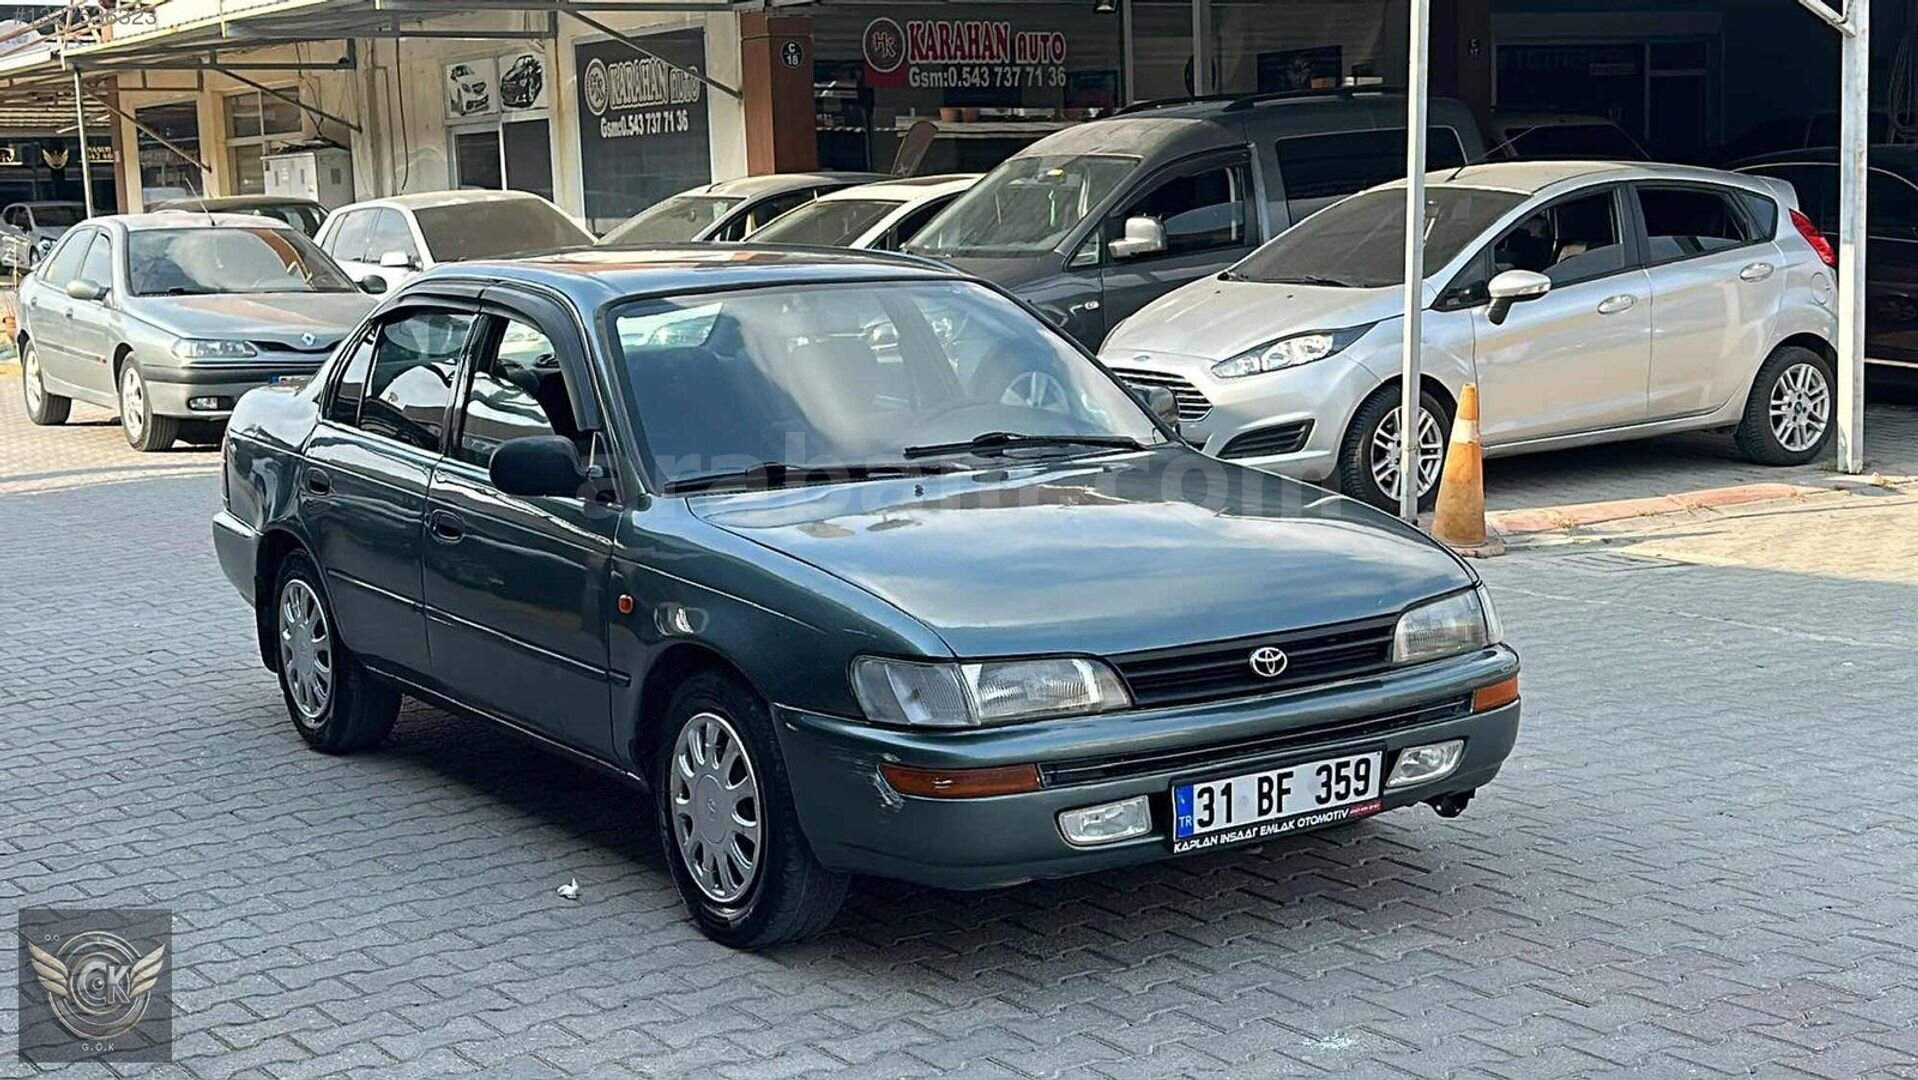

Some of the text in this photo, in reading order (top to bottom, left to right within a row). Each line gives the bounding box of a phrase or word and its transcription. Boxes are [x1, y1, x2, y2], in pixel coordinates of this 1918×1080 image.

[787, 43, 796, 53] C
[906, 20, 1067, 65] KARAHAN AUTO
[785, 55, 799, 65] 18
[608, 57, 669, 110] KARAHAN
[909, 66, 1067, 88] Gsm:0.543 737 71 36
[600, 109, 689, 138] Gsm:0.543 737 71 36
[1197, 758, 1372, 828] 31 BF 359
[1173, 834, 1218, 854] KAPLAN
[1219, 827, 1259, 844] INSAAT
[1260, 820, 1296, 836] EMLAK
[1297, 808, 1350, 827] OTOMOTIV
[1178, 815, 1193, 829] TR
